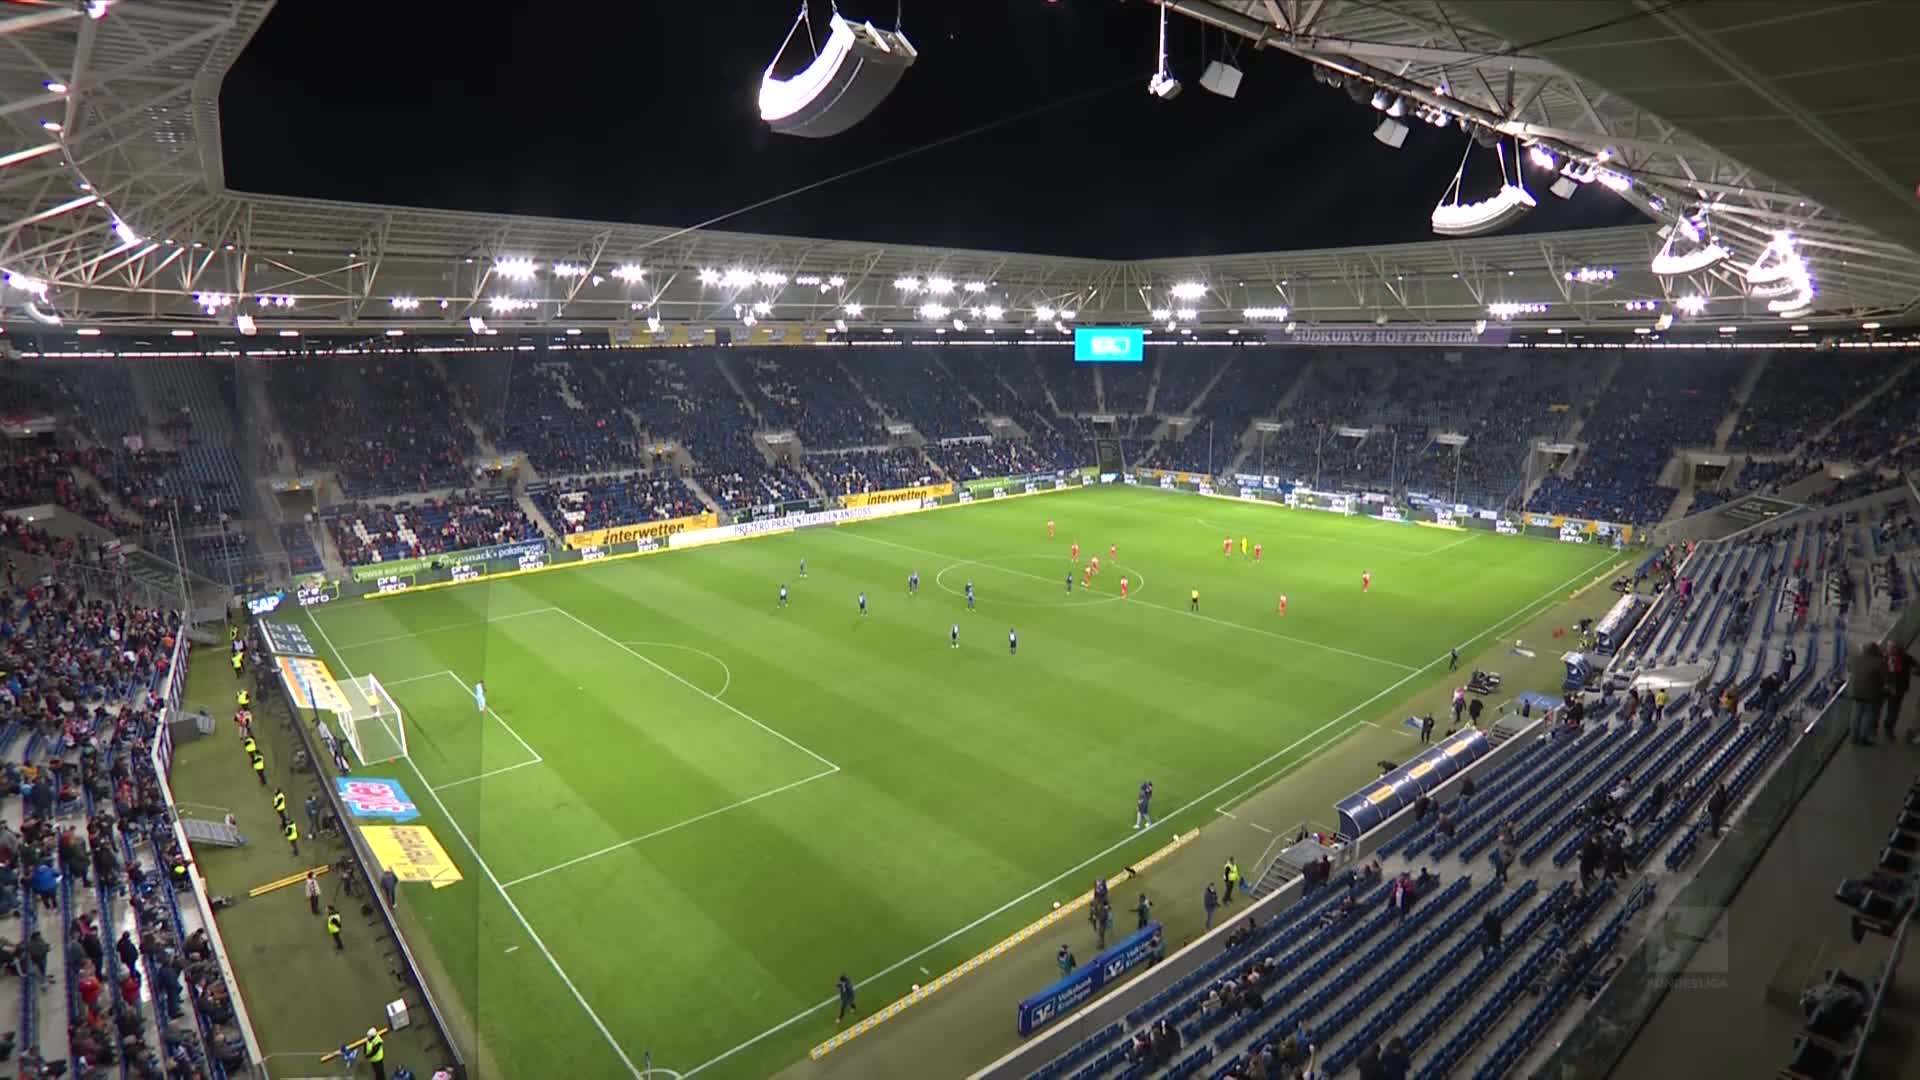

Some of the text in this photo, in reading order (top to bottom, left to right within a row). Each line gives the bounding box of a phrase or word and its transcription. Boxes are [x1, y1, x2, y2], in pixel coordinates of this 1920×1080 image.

[1375, 328, 1479, 343] HOFFENHEIM
[867, 489, 928, 505] interwetten
[603, 522, 685, 544] interwetten
[297, 587, 320, 601] pre
[299, 594, 330, 606] zero
[247, 596, 281, 615] SAP
